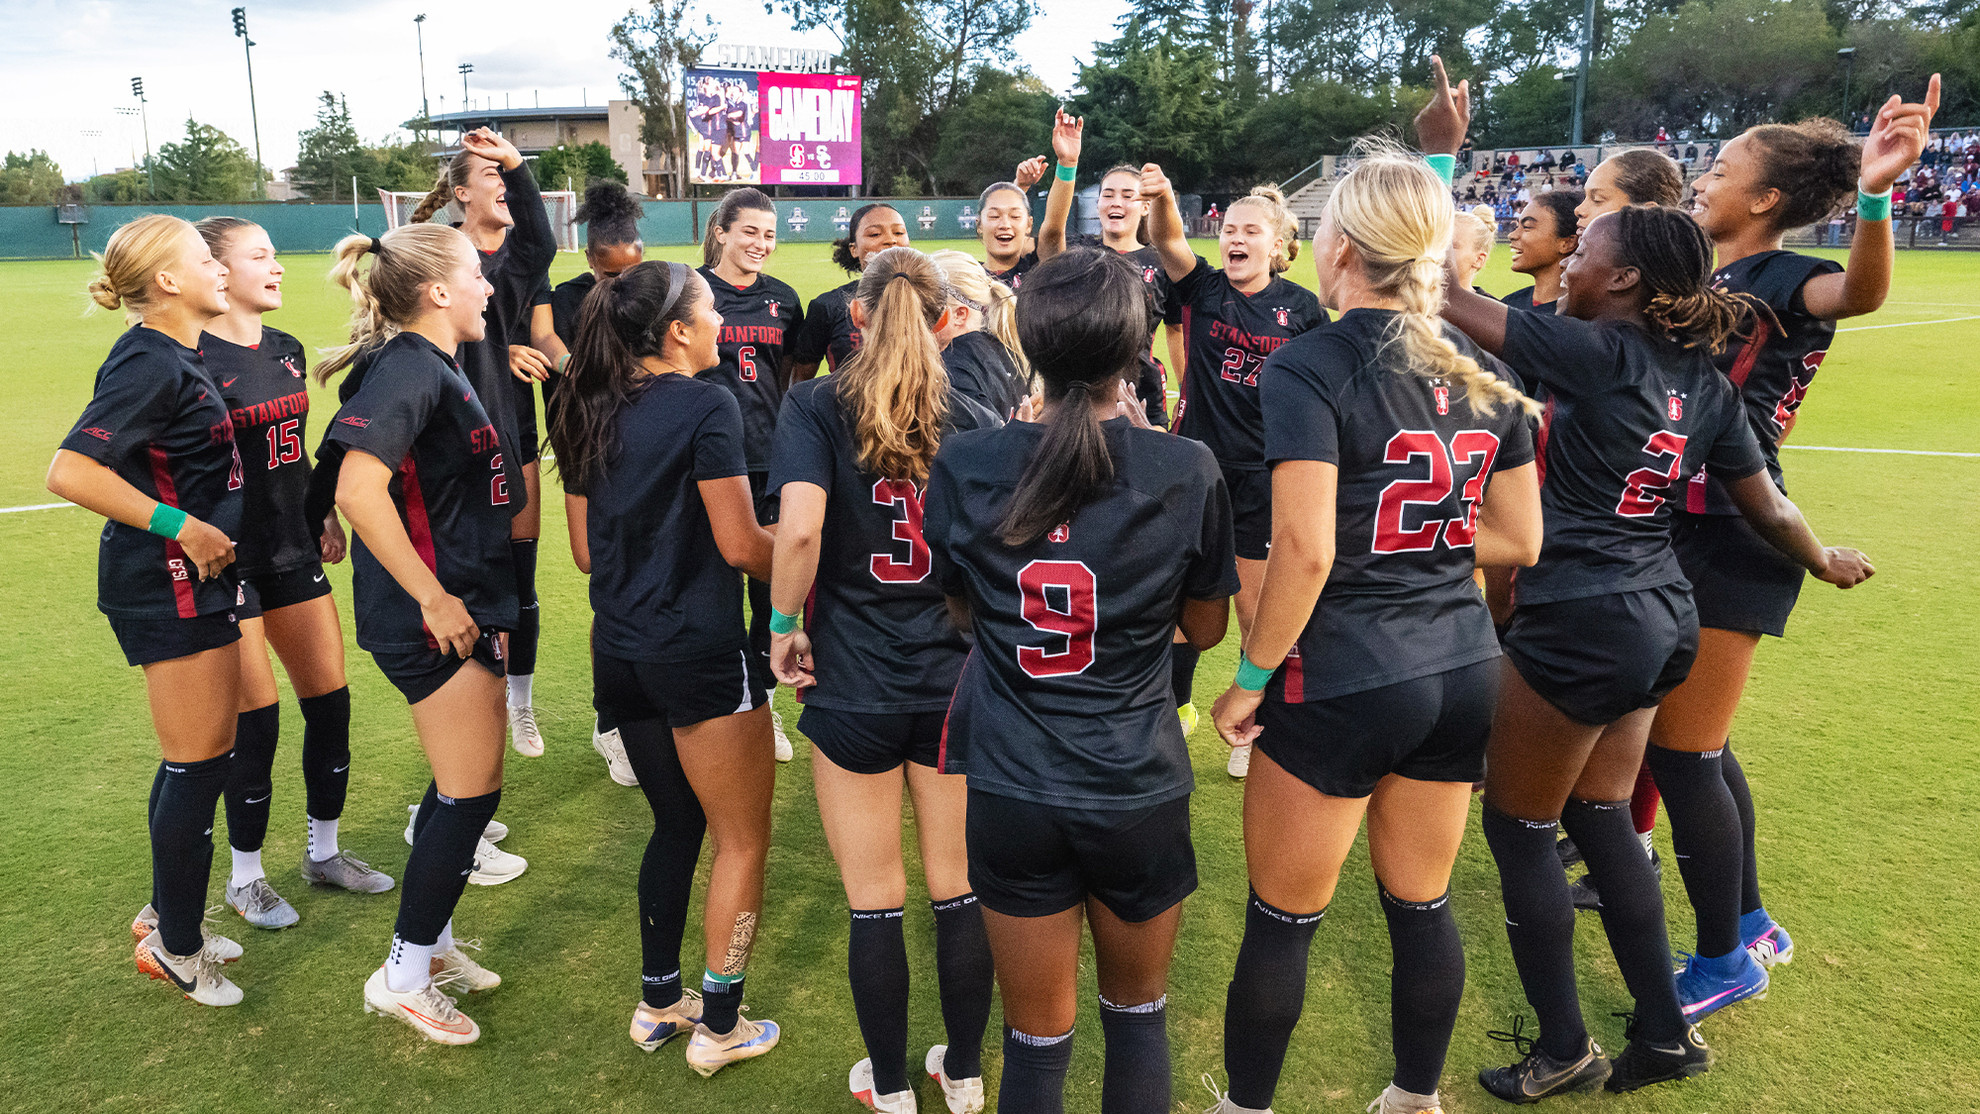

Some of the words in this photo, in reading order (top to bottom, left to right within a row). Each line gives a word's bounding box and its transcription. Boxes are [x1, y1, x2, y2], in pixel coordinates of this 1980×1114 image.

[718, 44, 831, 74] STANFORD
[767, 86, 855, 142] GAMEDAY
[716, 326, 783, 345] TANFORD
[738, 346, 758, 382] 6
[1221, 346, 1268, 387] 27
[82, 427, 114, 441] ACC
[266, 418, 302, 470] 15
[1371, 429, 1500, 555] 23
[1615, 430, 1688, 517] 2
[1017, 559, 1098, 678] 9
[852, 912, 882, 920] NIKE
[1255, 900, 1293, 924] NIKE
